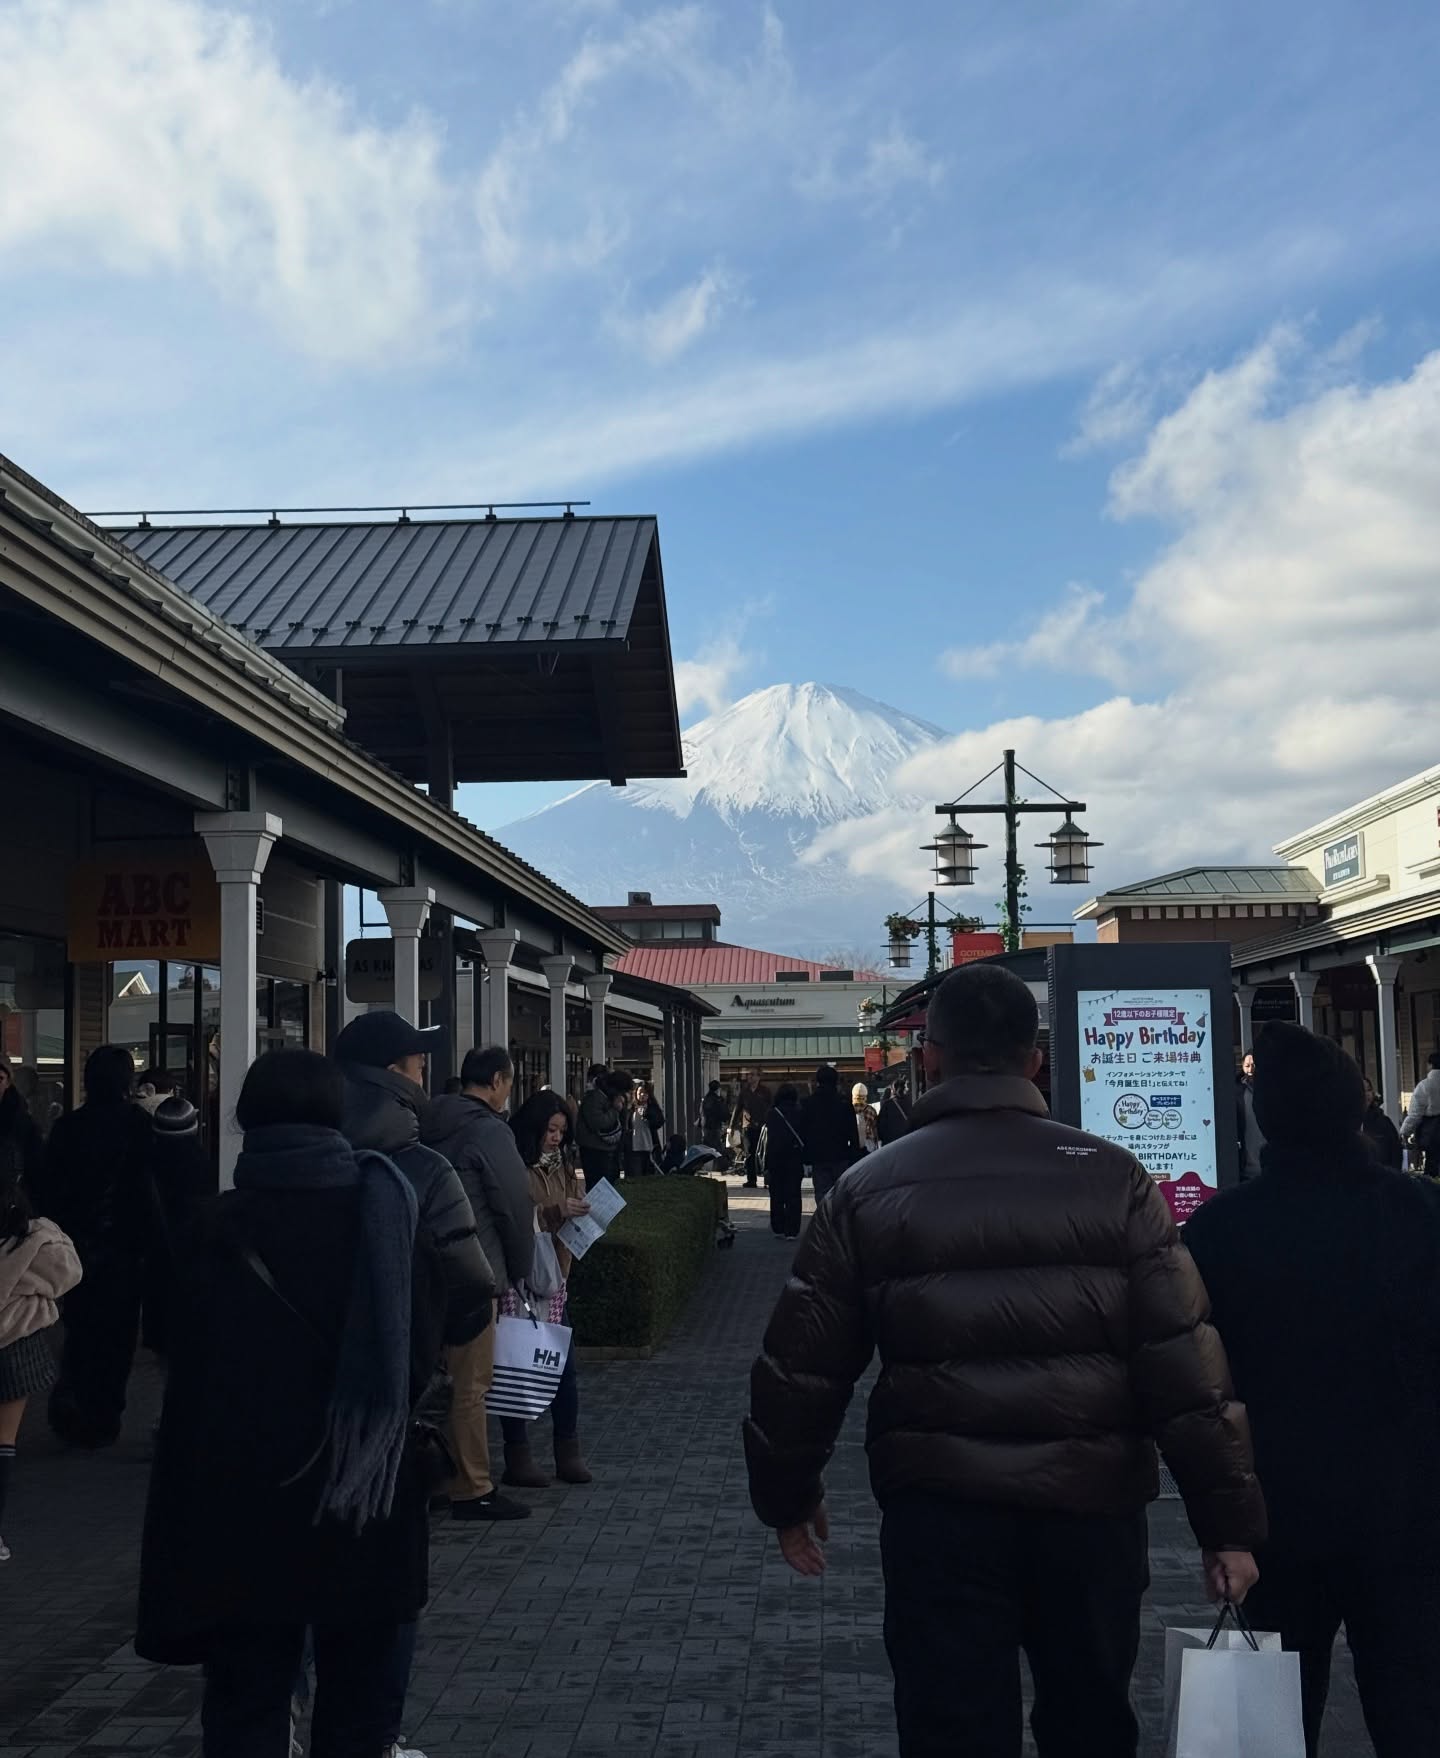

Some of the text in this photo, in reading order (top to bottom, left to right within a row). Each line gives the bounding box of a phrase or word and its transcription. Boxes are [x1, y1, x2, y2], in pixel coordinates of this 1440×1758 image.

[97, 872, 191, 916] ABC
[97, 919, 192, 948] MART
[353, 959, 369, 973] AS
[730, 995, 795, 1010] Aquascutum
[1084, 1026, 1206, 1051] Happy Birthday
[1091, 1051, 1201, 1064] お誕生日 ご来場特典
[1119, 1108, 1143, 1116] Birthday
[1121, 1100, 1140, 1110] Happy
[533, 1348, 560, 1367] HH
